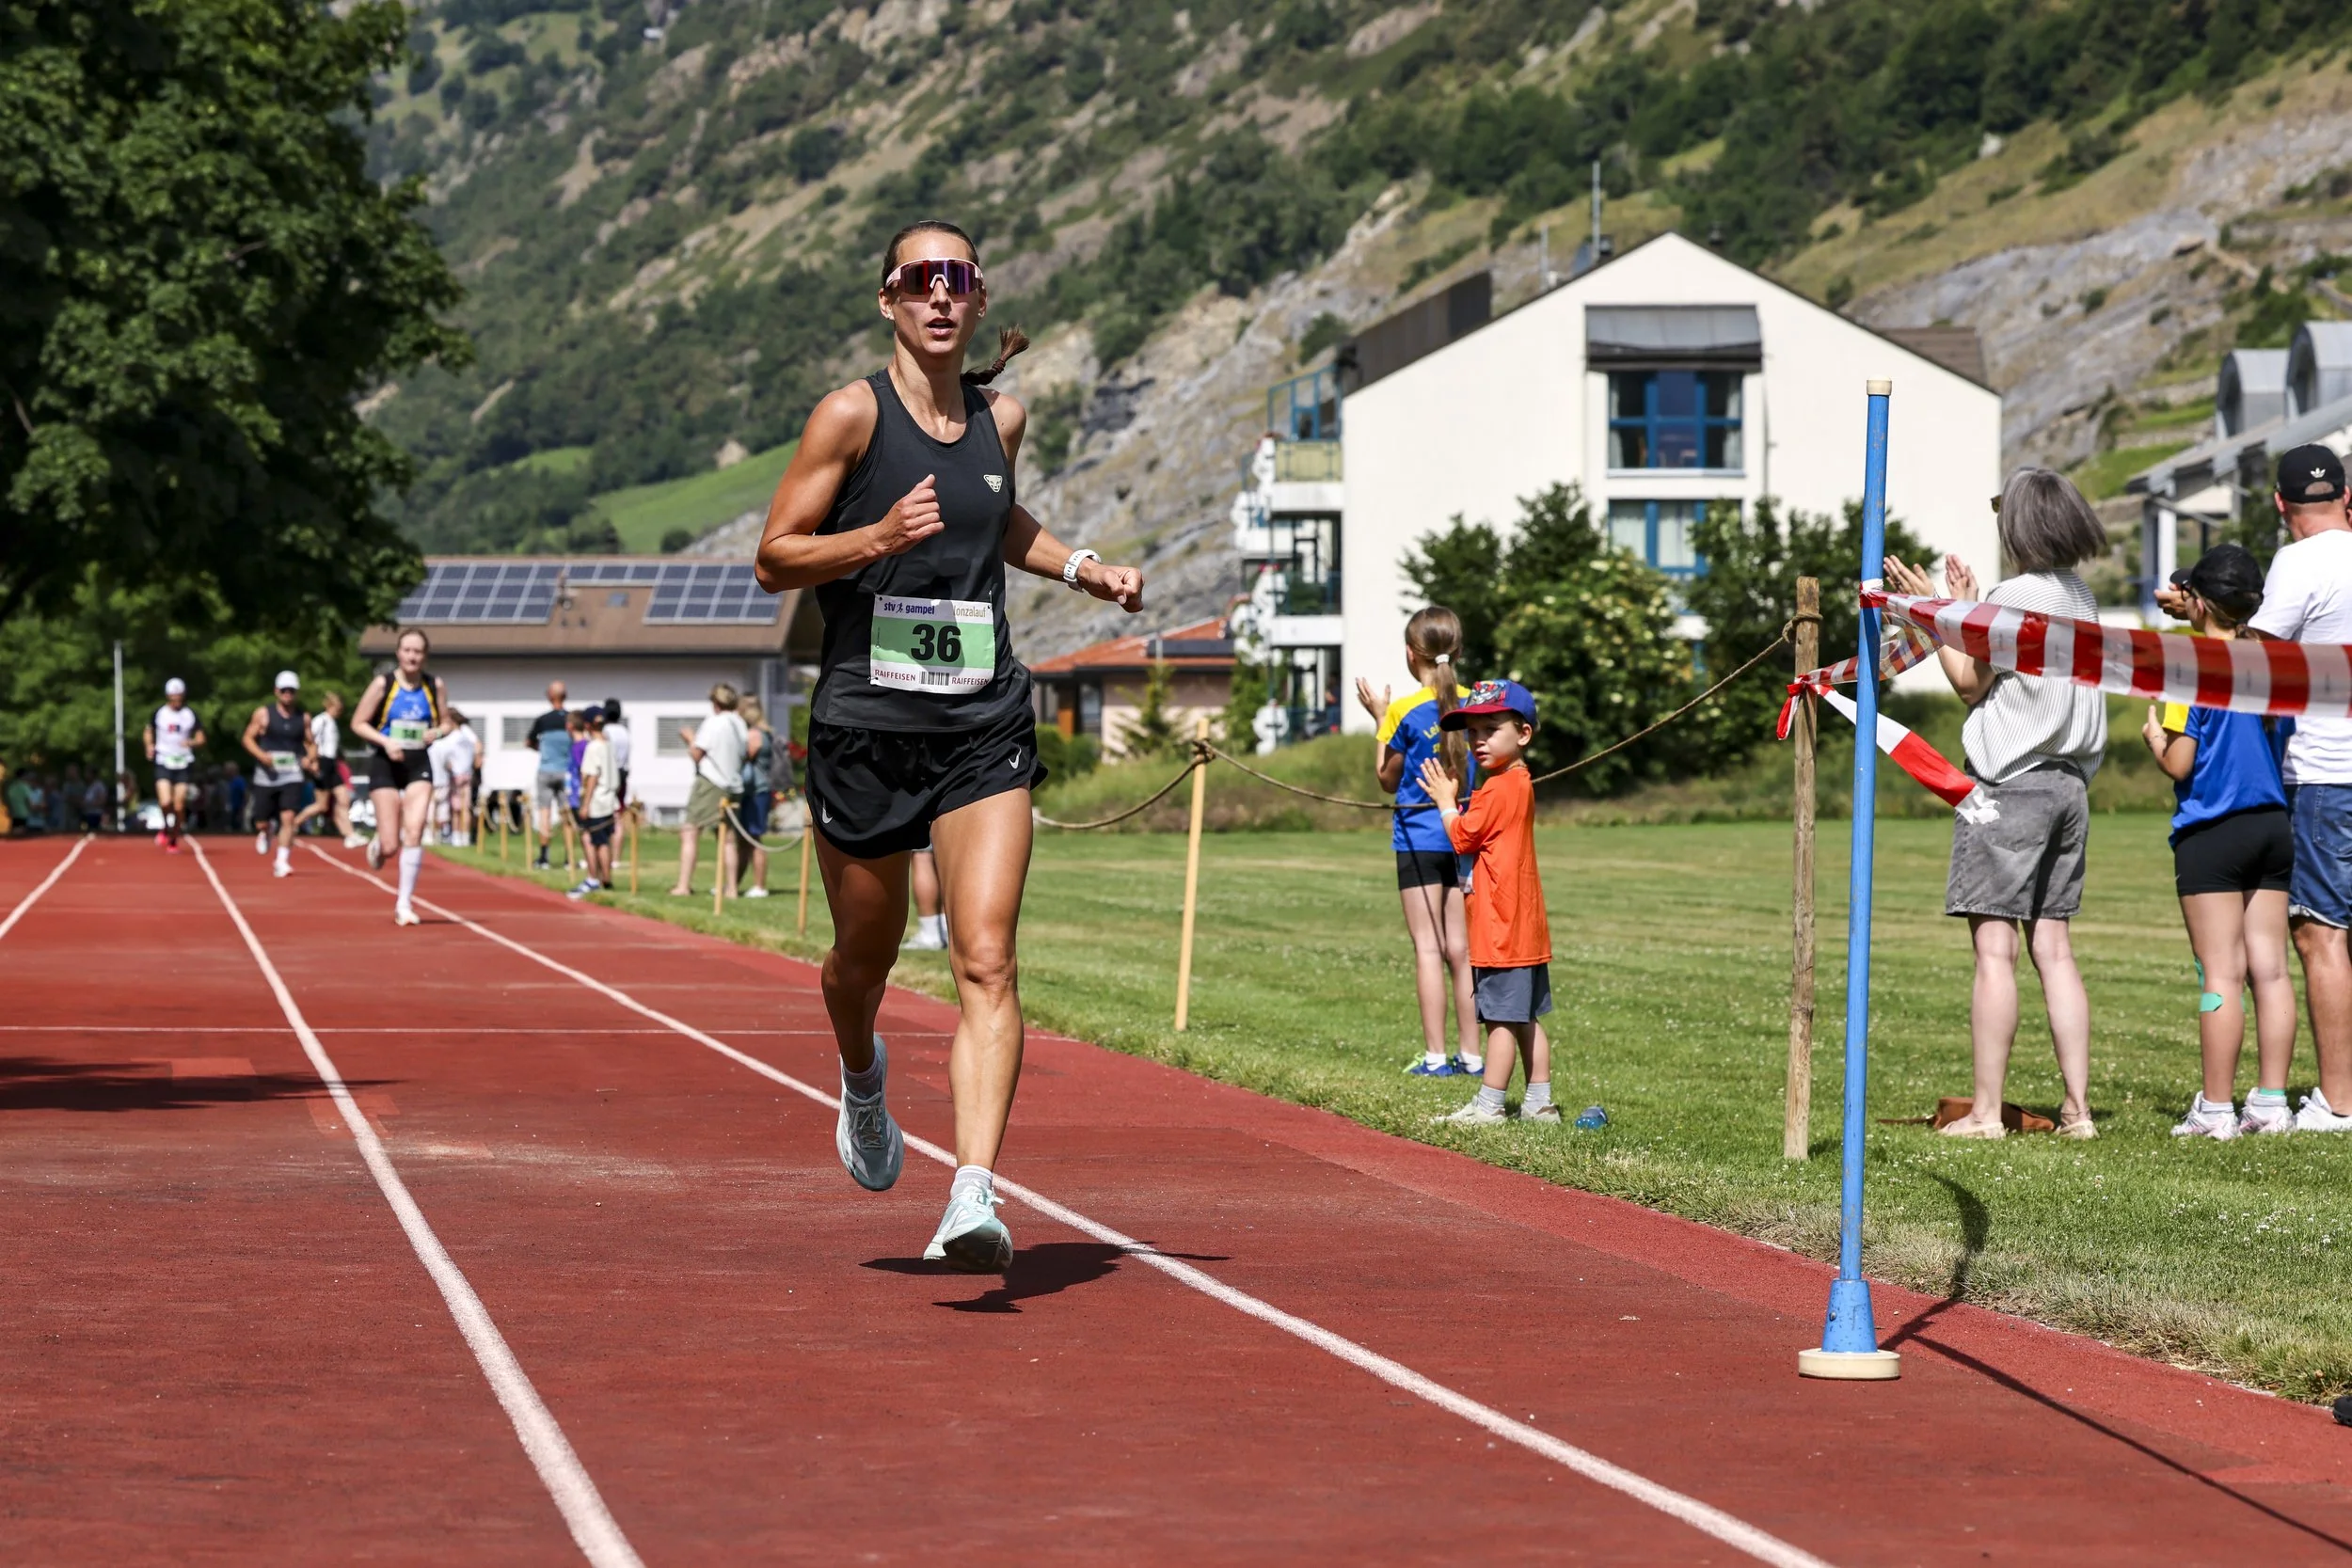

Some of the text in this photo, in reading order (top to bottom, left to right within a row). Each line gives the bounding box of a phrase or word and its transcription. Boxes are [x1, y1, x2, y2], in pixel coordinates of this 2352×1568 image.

[883, 602, 935, 615] stv gampel
[911, 624, 961, 662] 36
[875, 670, 915, 681] RAIFFEISEN
[951, 676, 989, 686] RAIFFEISEN
